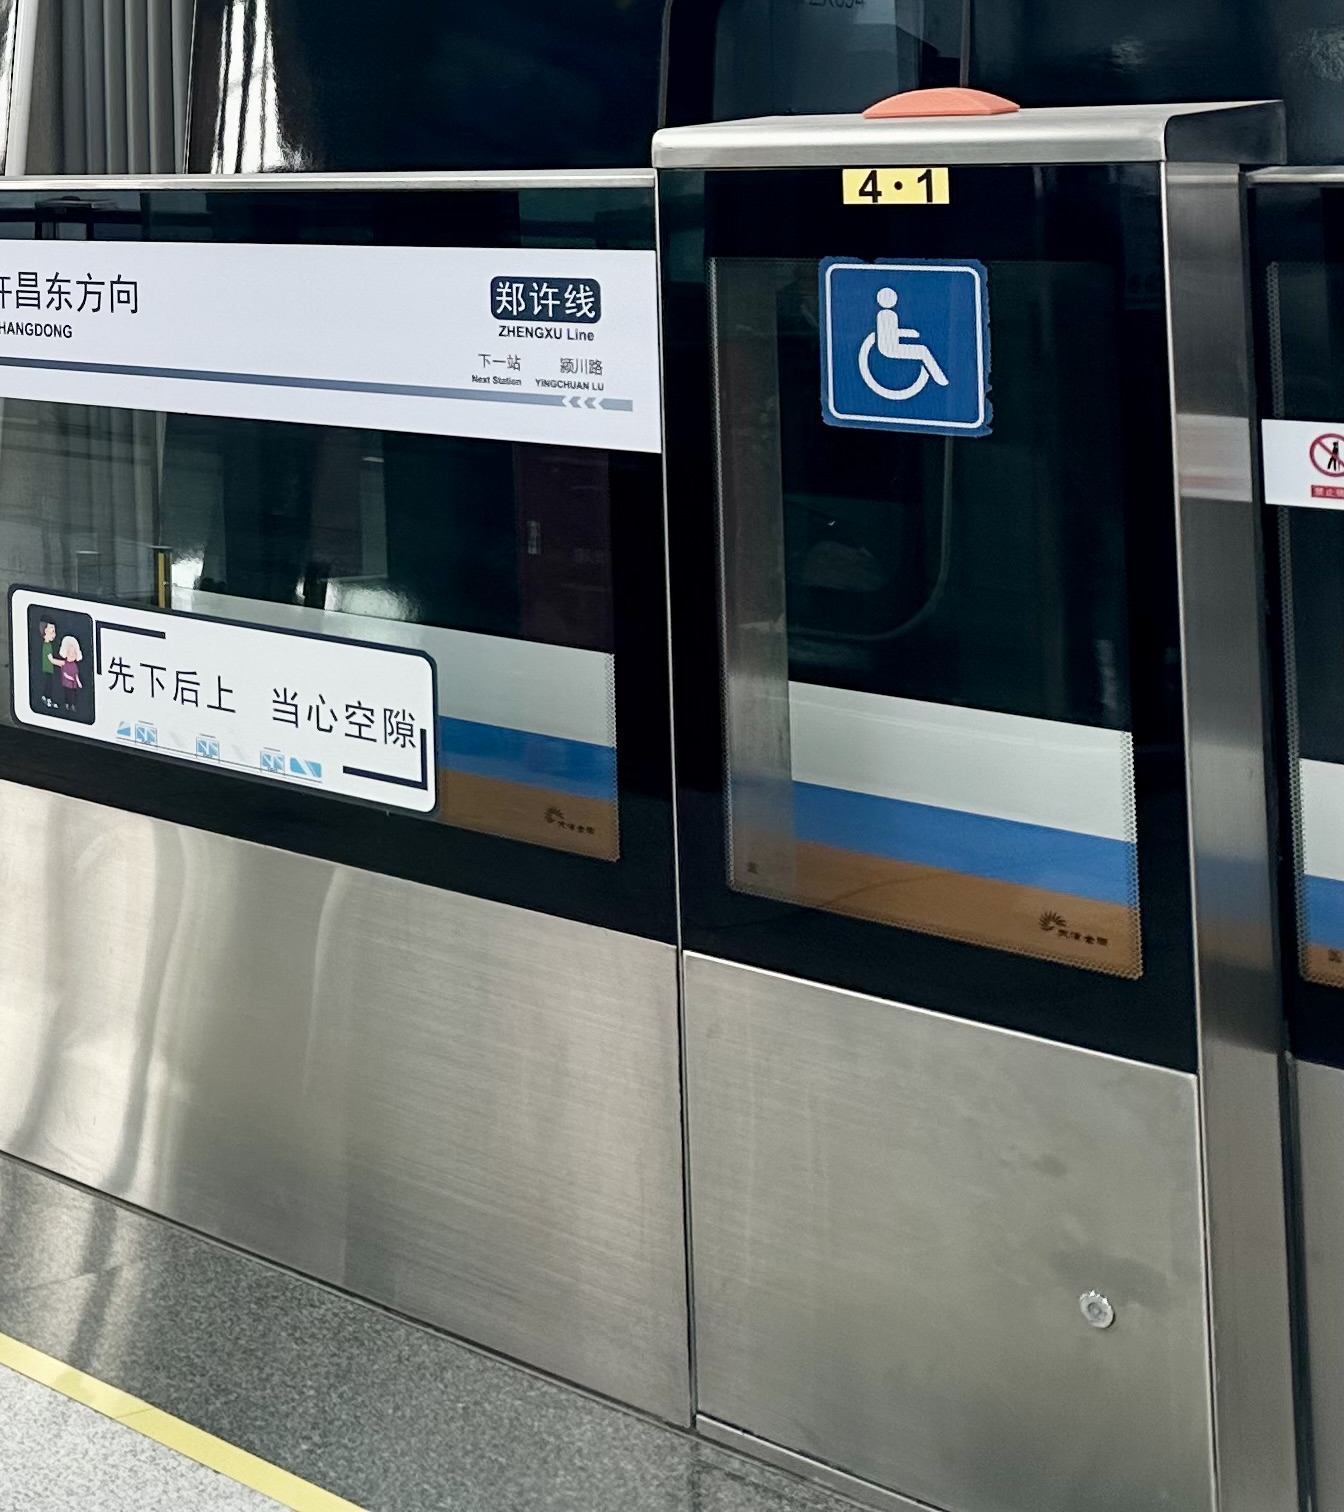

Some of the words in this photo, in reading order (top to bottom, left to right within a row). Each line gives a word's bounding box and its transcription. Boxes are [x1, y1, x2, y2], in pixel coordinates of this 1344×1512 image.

[495, 281, 596, 319] 郑许线
[498, 325, 562, 340] ZHENGXU
[567, 328, 594, 341] Line
[478, 353, 522, 371] 下一站
[472, 375, 490, 384] Next
[493, 376, 522, 386] Station
[535, 378, 589, 390] YINGCHUAN
[592, 382, 604, 391] LU
[107, 656, 237, 714] 先下后上
[271, 687, 417, 750] 当心空隙
